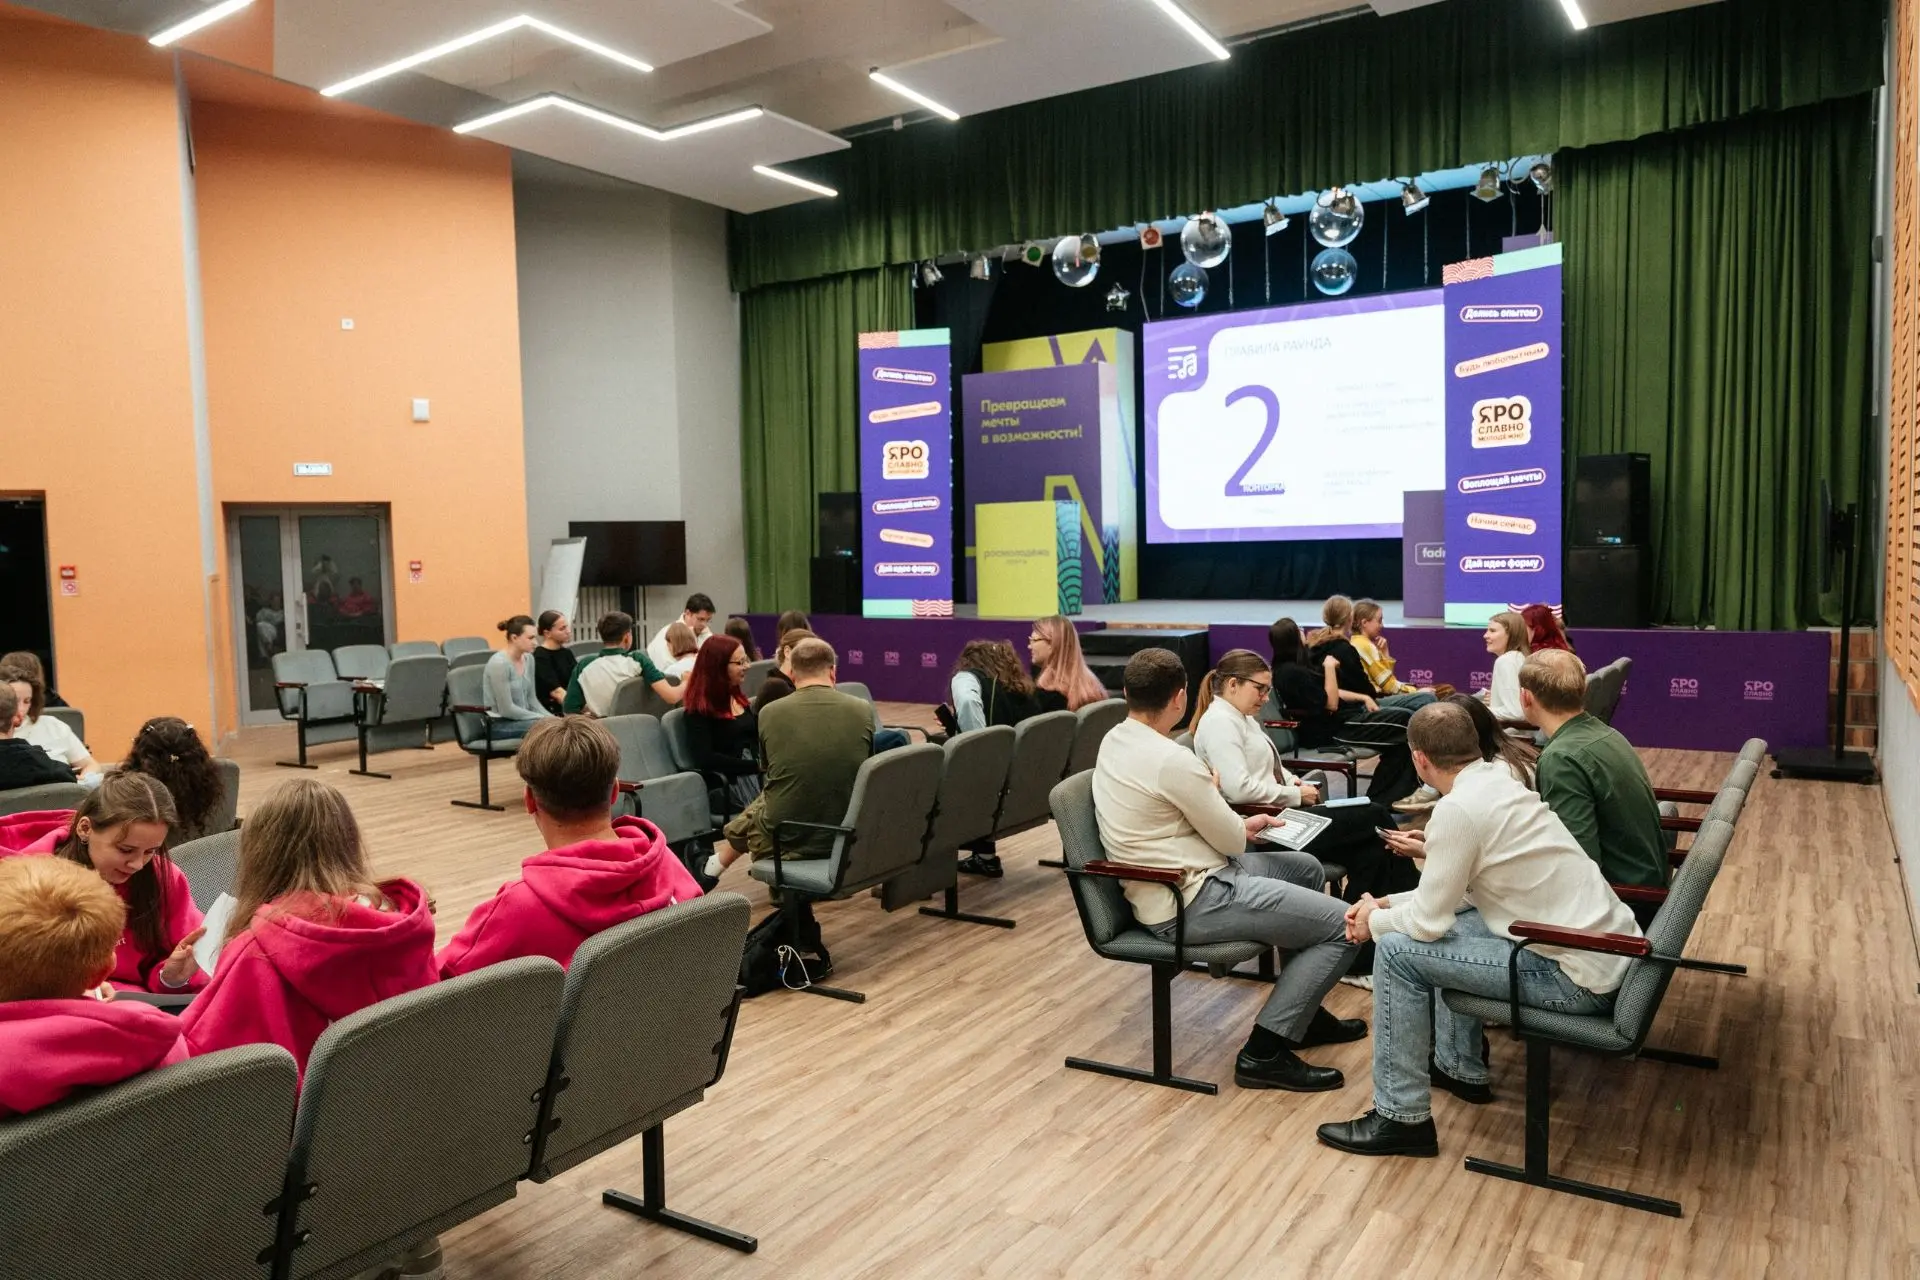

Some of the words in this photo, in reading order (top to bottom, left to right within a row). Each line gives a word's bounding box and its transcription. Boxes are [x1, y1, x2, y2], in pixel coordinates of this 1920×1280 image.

[981, 397, 1067, 415] Превращаем
[1479, 403, 1524, 423] ЯРО
[982, 417, 1019, 428] мечты
[1478, 423, 1524, 434] СЛАВНО
[981, 433, 989, 444] в
[992, 424, 1083, 443] возможности!
[1225, 384, 1285, 496] 2
[888, 446, 923, 460] ЯРО
[1670, 678, 1698, 689] ЯРО
[1744, 680, 1774, 691] ЯРО
